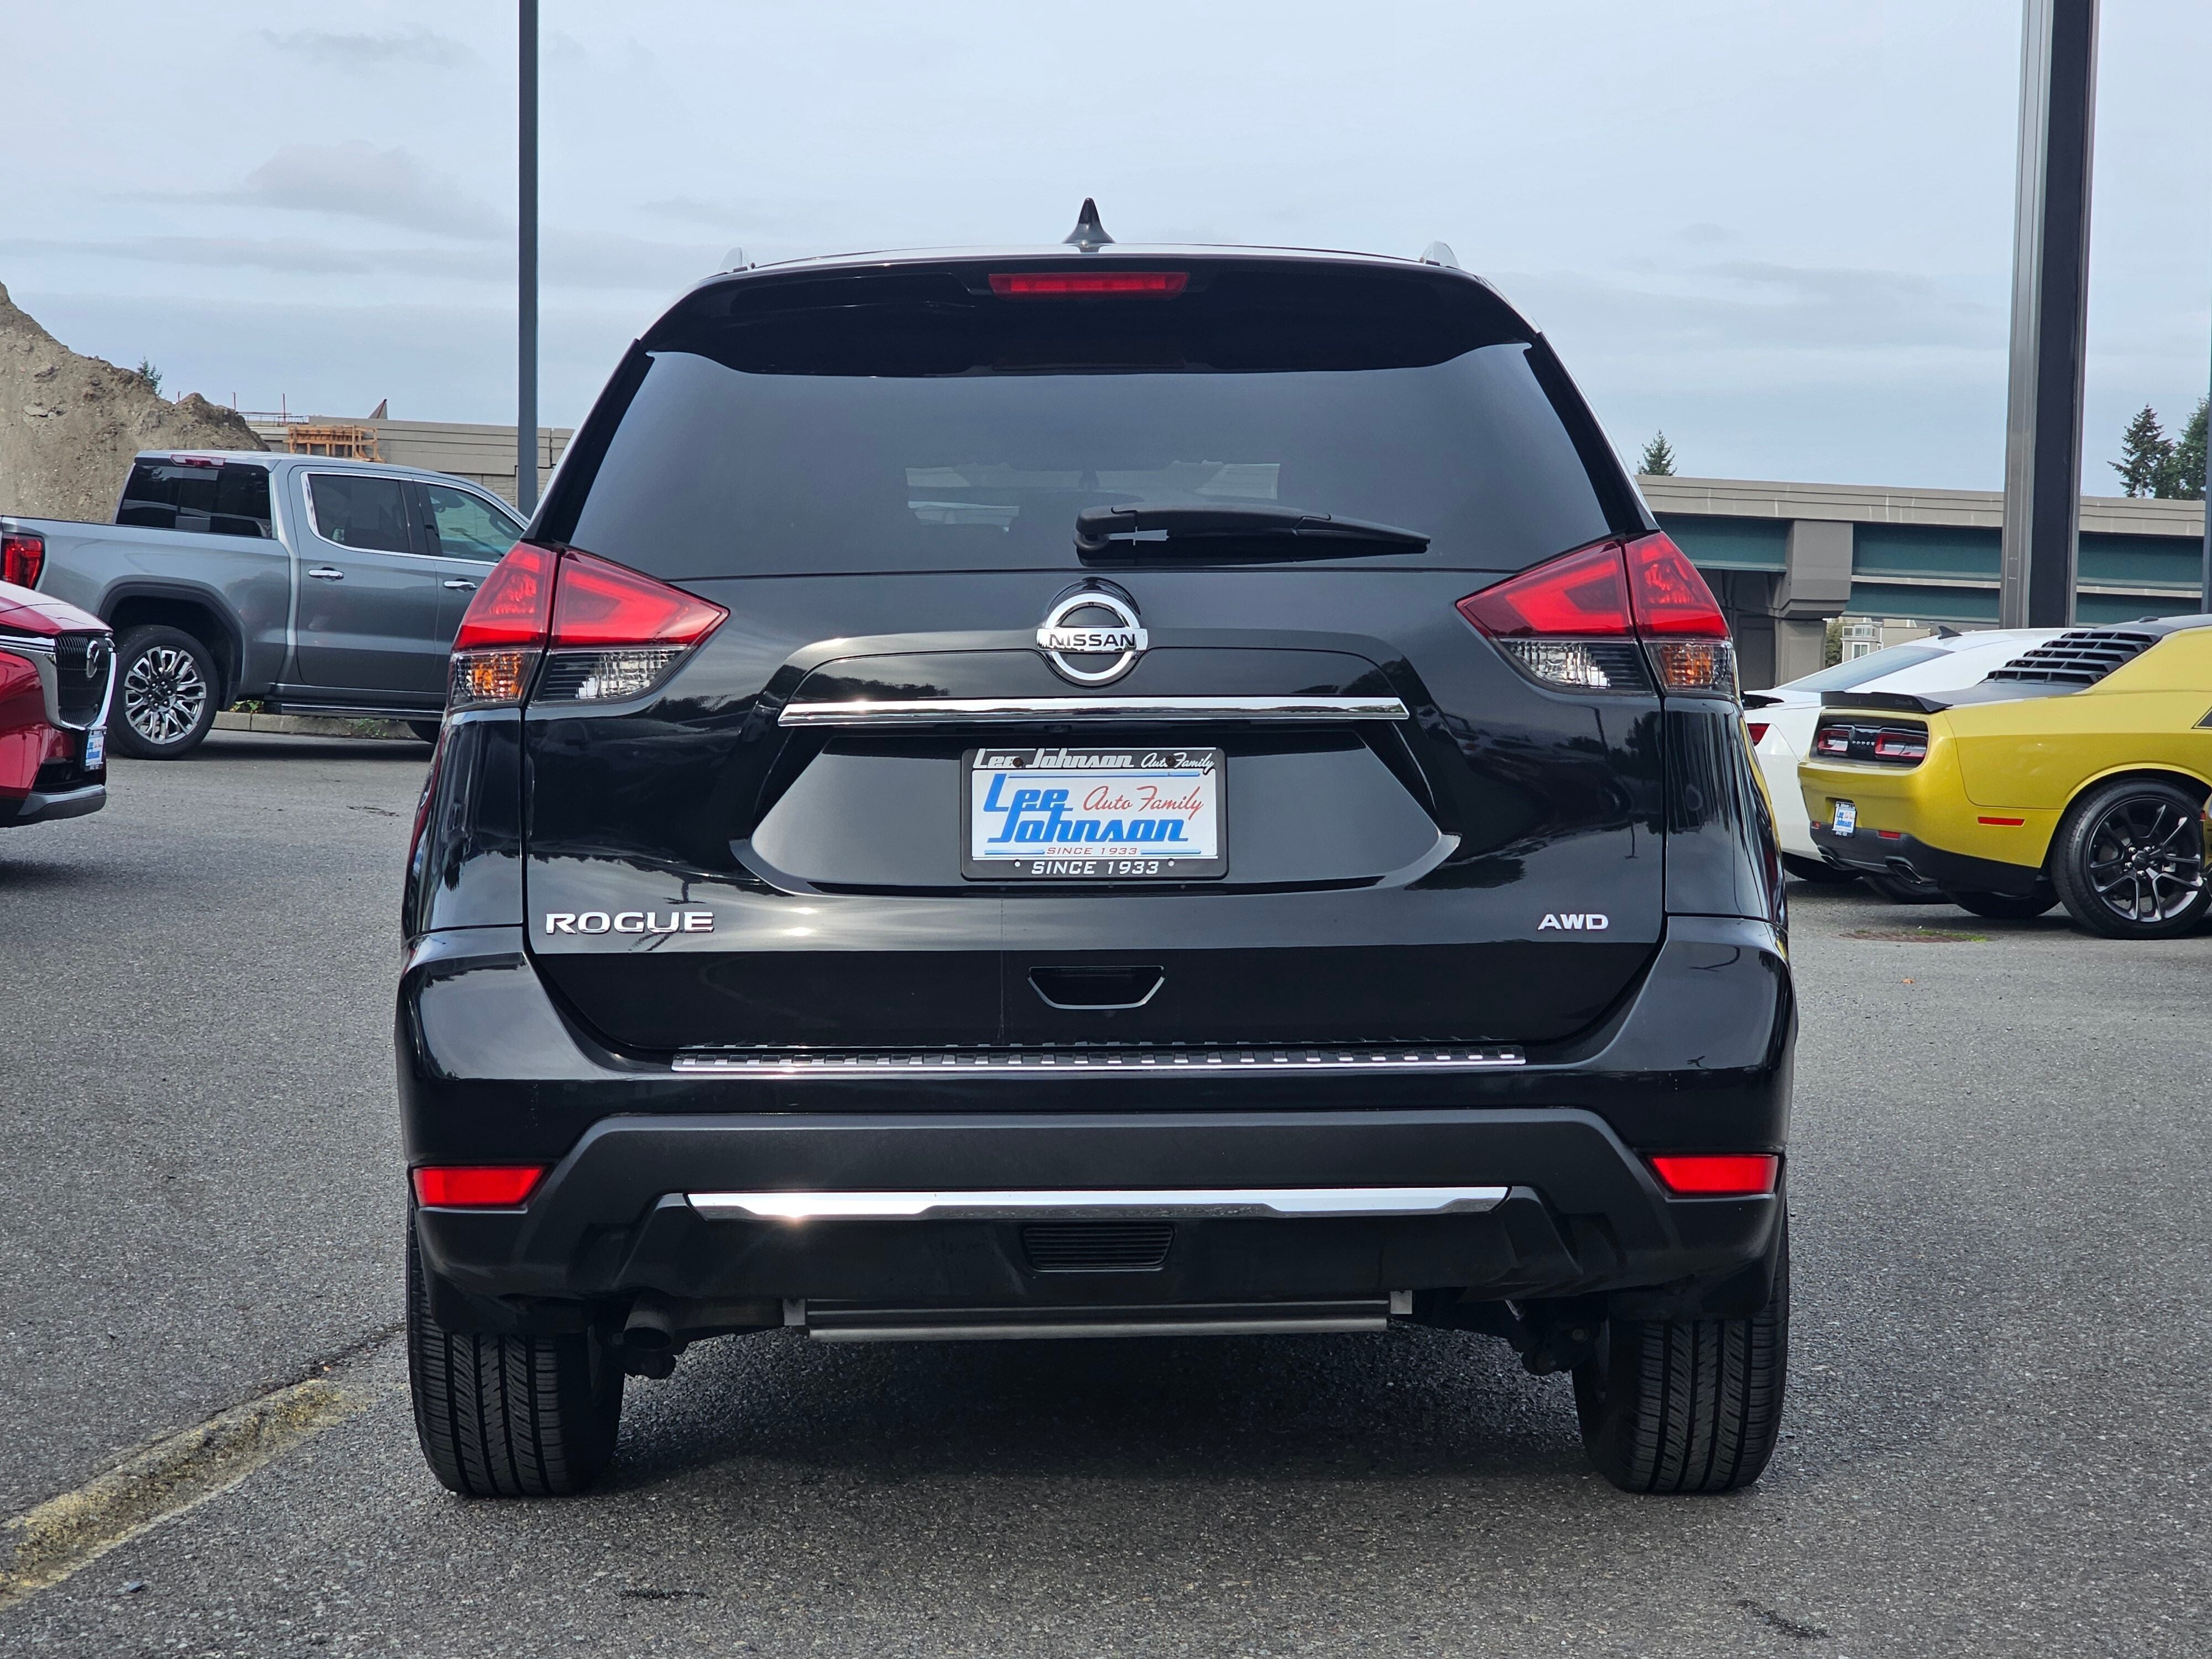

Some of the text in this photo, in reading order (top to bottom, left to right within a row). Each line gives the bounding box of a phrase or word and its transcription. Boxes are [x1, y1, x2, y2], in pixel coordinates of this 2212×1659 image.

[1050, 633, 1135, 646] NISSAN
[1025, 748, 1134, 768] Johnson
[1173, 752, 1215, 774] Family
[983, 773, 1204, 820] Lee Auto Family
[987, 790, 1188, 843] Johnson
[1031, 860, 1159, 874] SINCE 1933
[546, 911, 714, 933] ROGUE
[1537, 914, 1609, 930] AWD
